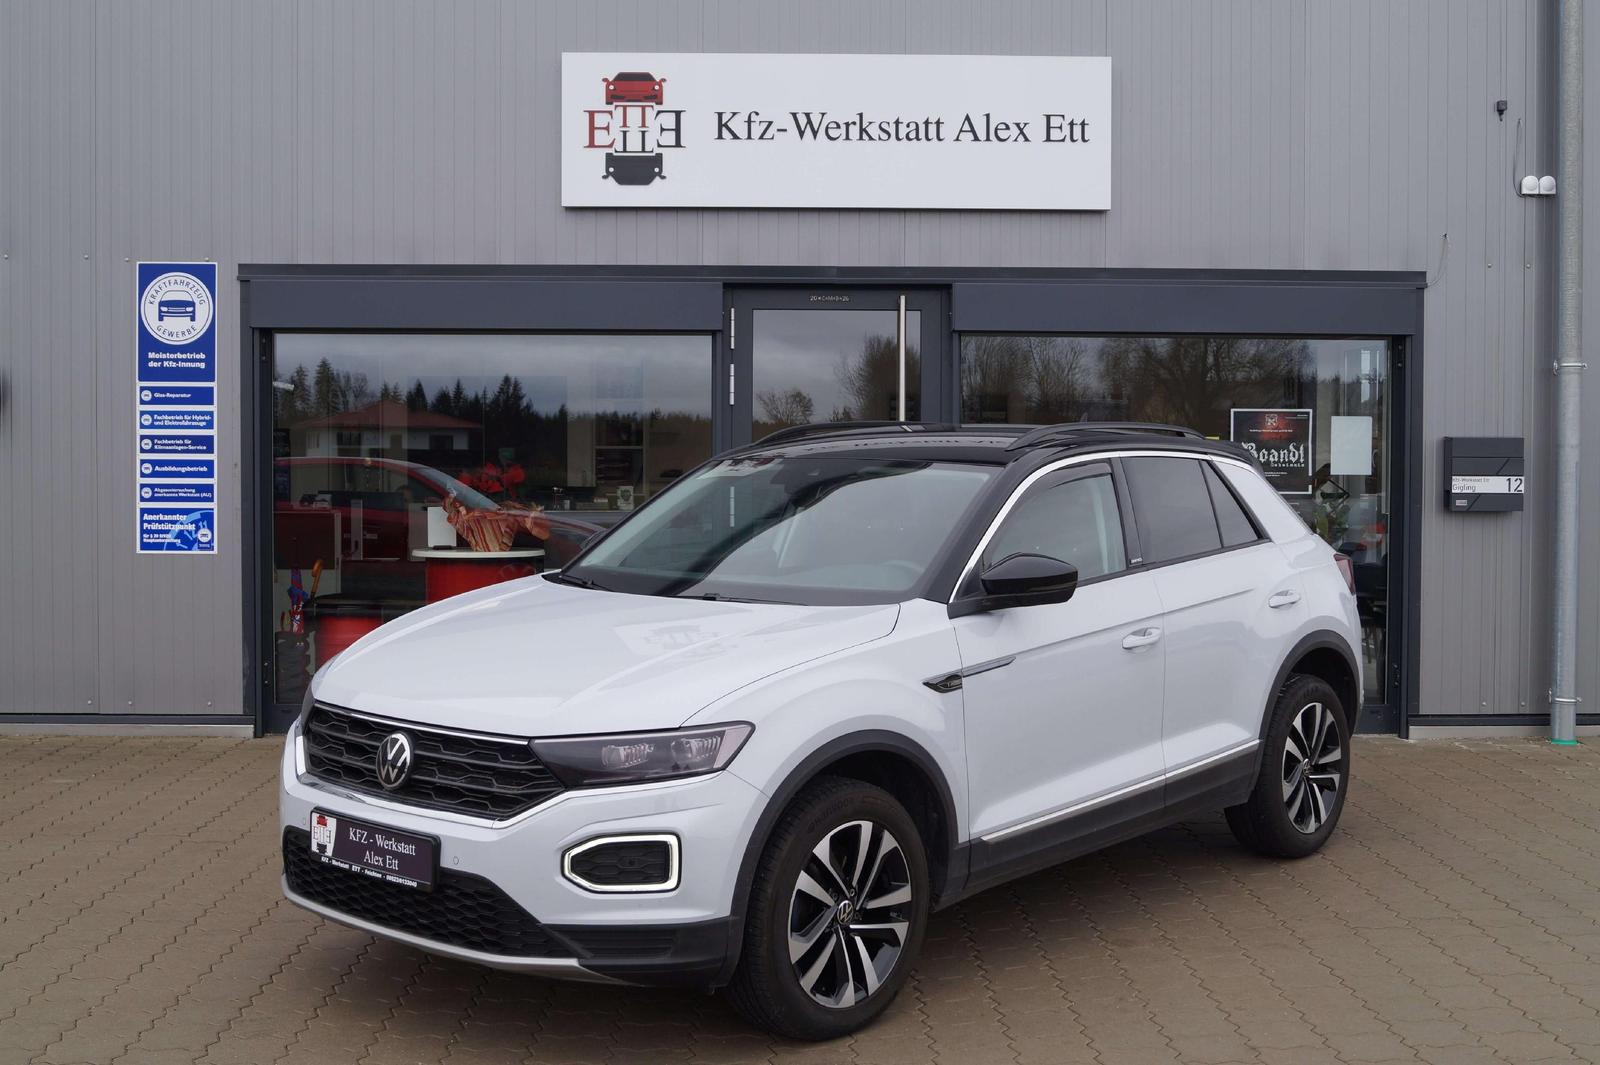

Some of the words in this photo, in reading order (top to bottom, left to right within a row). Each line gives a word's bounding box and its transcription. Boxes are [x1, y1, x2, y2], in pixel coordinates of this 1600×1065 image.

[714, 111, 945, 142] Kfz-Werkstatt
[953, 113, 1032, 143] Alex
[1042, 113, 1090, 143] Ett
[148, 279, 206, 306] KRAFTFAHRZEUG
[156, 324, 197, 339] GEWERBE
[148, 352, 206, 360] Meisterbetrieb
[163, 361, 206, 369] Kfz-Innung
[1452, 484, 1476, 493] Gigling
[1506, 478, 1523, 493] 12
[143, 513, 187, 521] Anerkannter
[143, 523, 196, 531] Prüfstützpunkt
[349, 827, 368, 844] KFZ
[375, 834, 416, 856] Werkstatt
[364, 850, 383, 866] Alex
[386, 855, 399, 870] Ett
